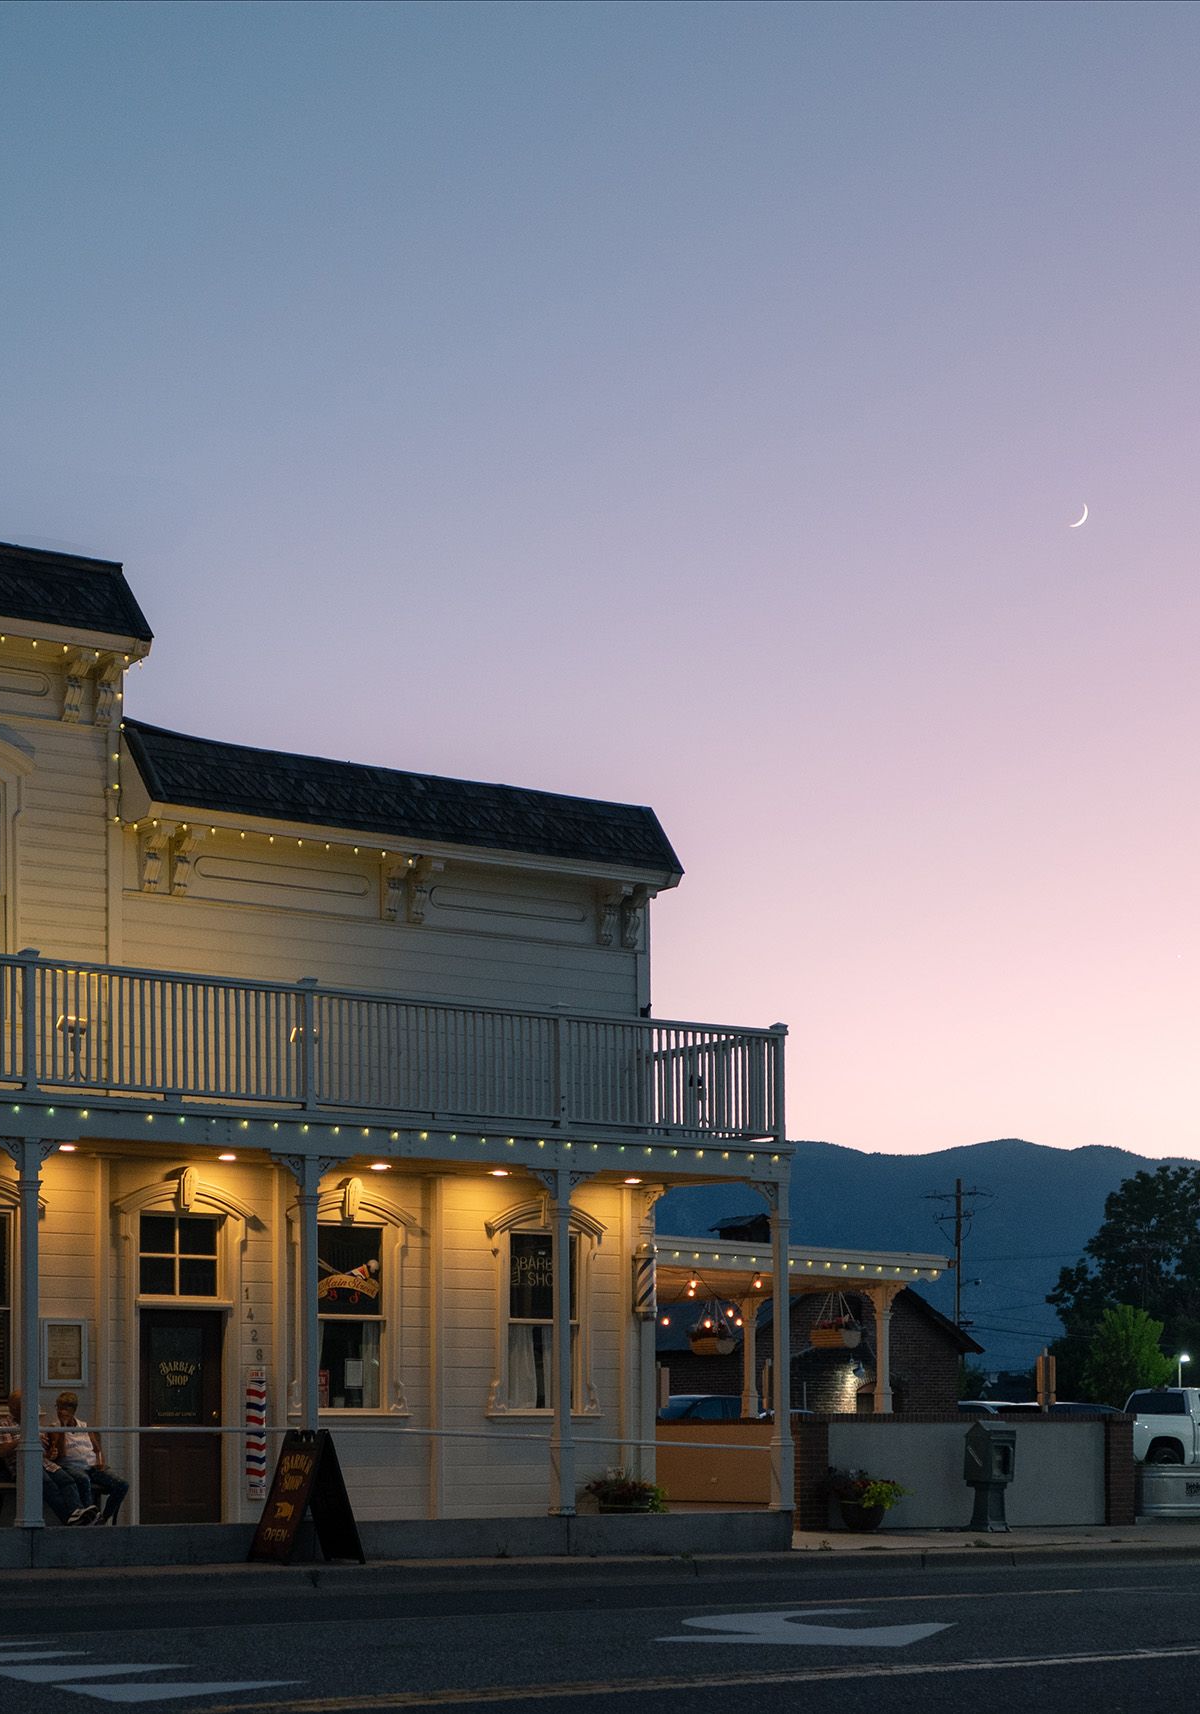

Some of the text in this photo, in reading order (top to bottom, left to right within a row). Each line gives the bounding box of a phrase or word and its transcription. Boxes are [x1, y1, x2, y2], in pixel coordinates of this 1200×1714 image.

[519, 1256, 553, 1271] BARB
[527, 1272, 553, 1287] SHO
[159, 1360, 196, 1376] BARBER
[166, 1374, 189, 1387] SHOP
[263, 1527, 288, 1544] OPEN
